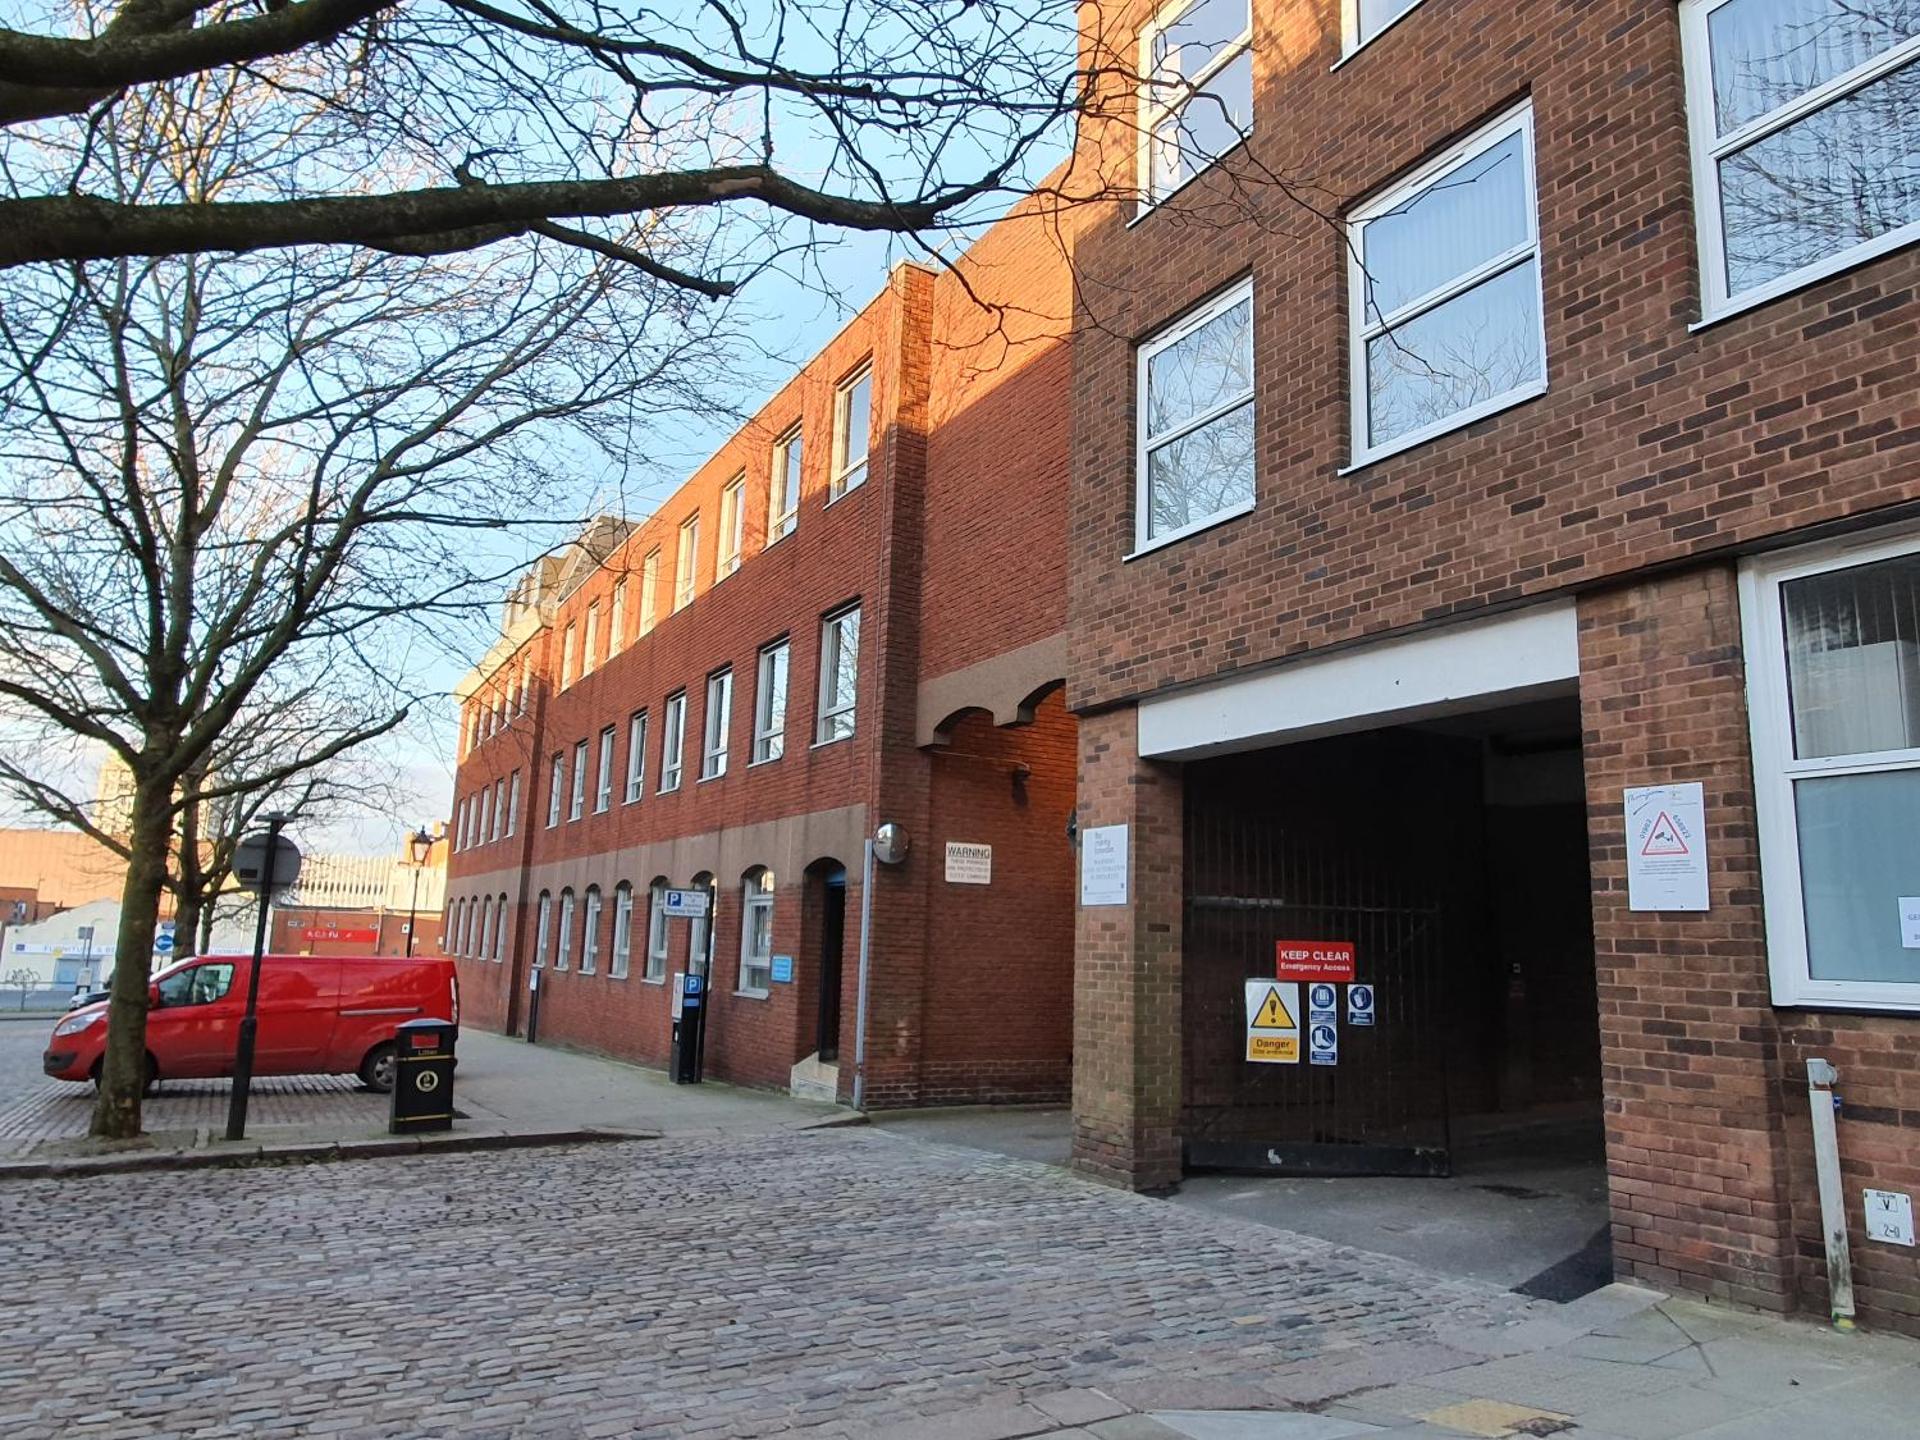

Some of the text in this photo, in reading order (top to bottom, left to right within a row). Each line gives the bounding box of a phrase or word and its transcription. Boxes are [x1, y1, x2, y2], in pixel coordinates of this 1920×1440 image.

[948, 846, 990, 859] WARNING
[1281, 950, 1350, 961] KEEP CLEAR
[1281, 962, 1350, 972] Emergency Access
[1256, 1039, 1290, 1050] Danger
